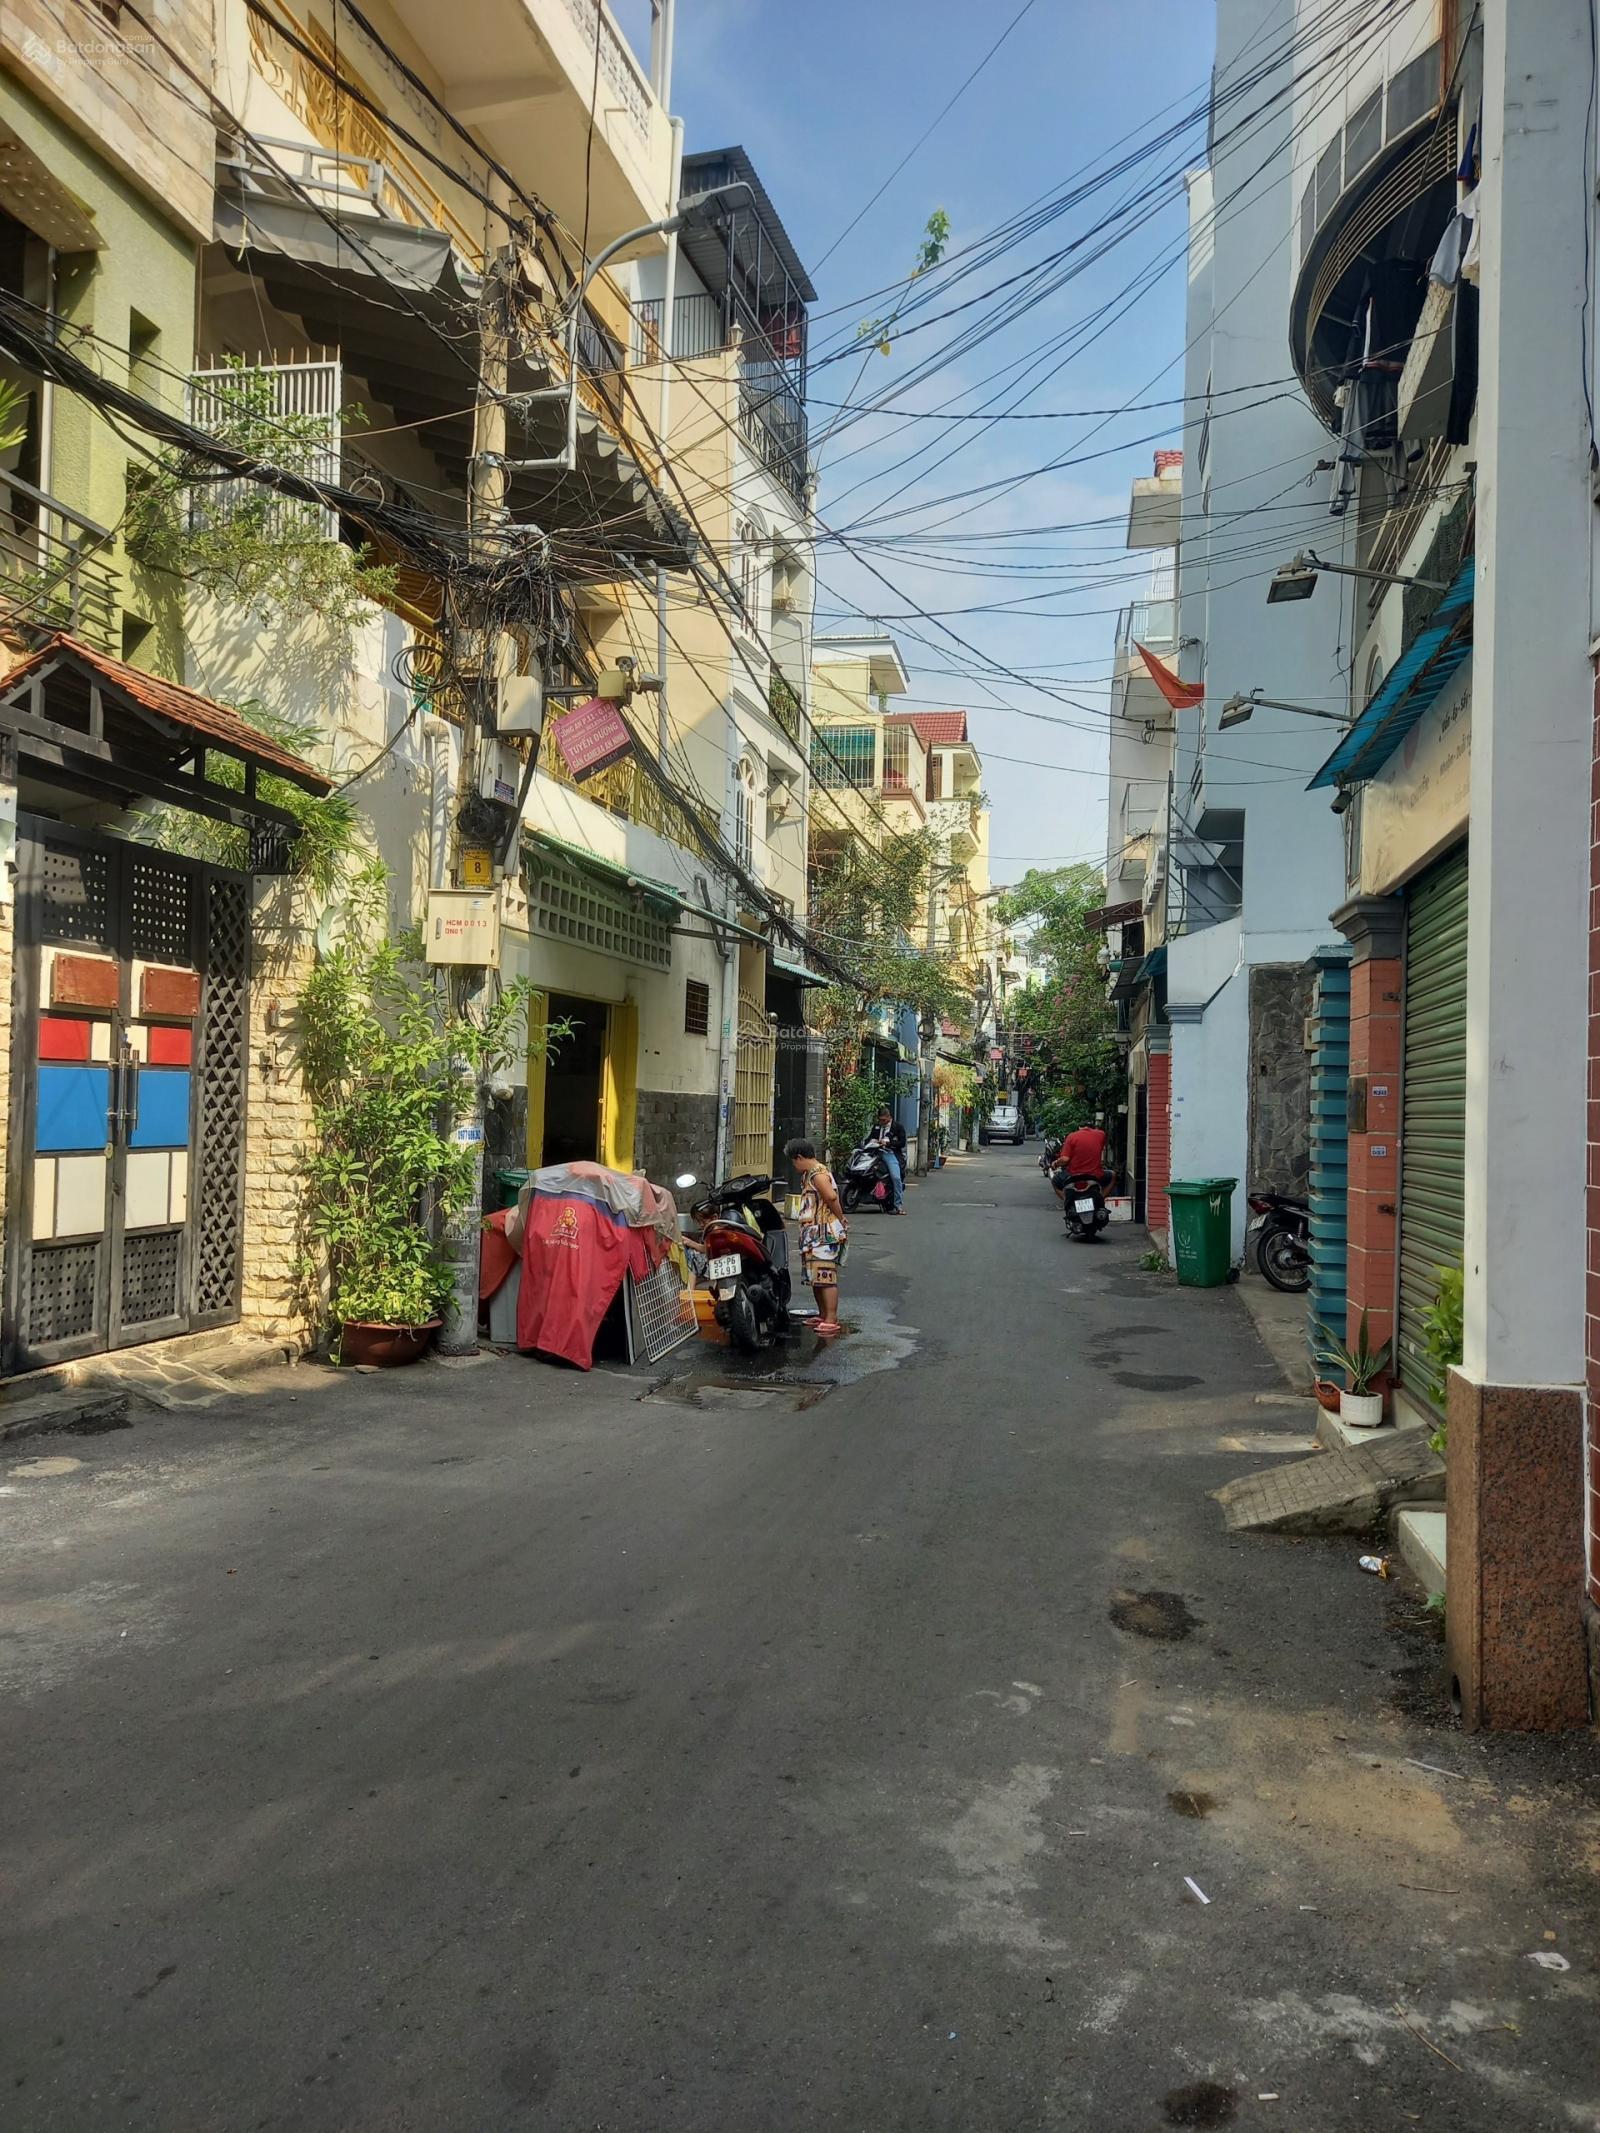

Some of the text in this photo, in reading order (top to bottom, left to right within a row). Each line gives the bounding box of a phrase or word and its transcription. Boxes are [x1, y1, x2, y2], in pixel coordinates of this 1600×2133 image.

[474, 861, 481, 873] 8
[714, 1256, 736, 1268] 55-P6
[714, 1265, 737, 1277] 5493
